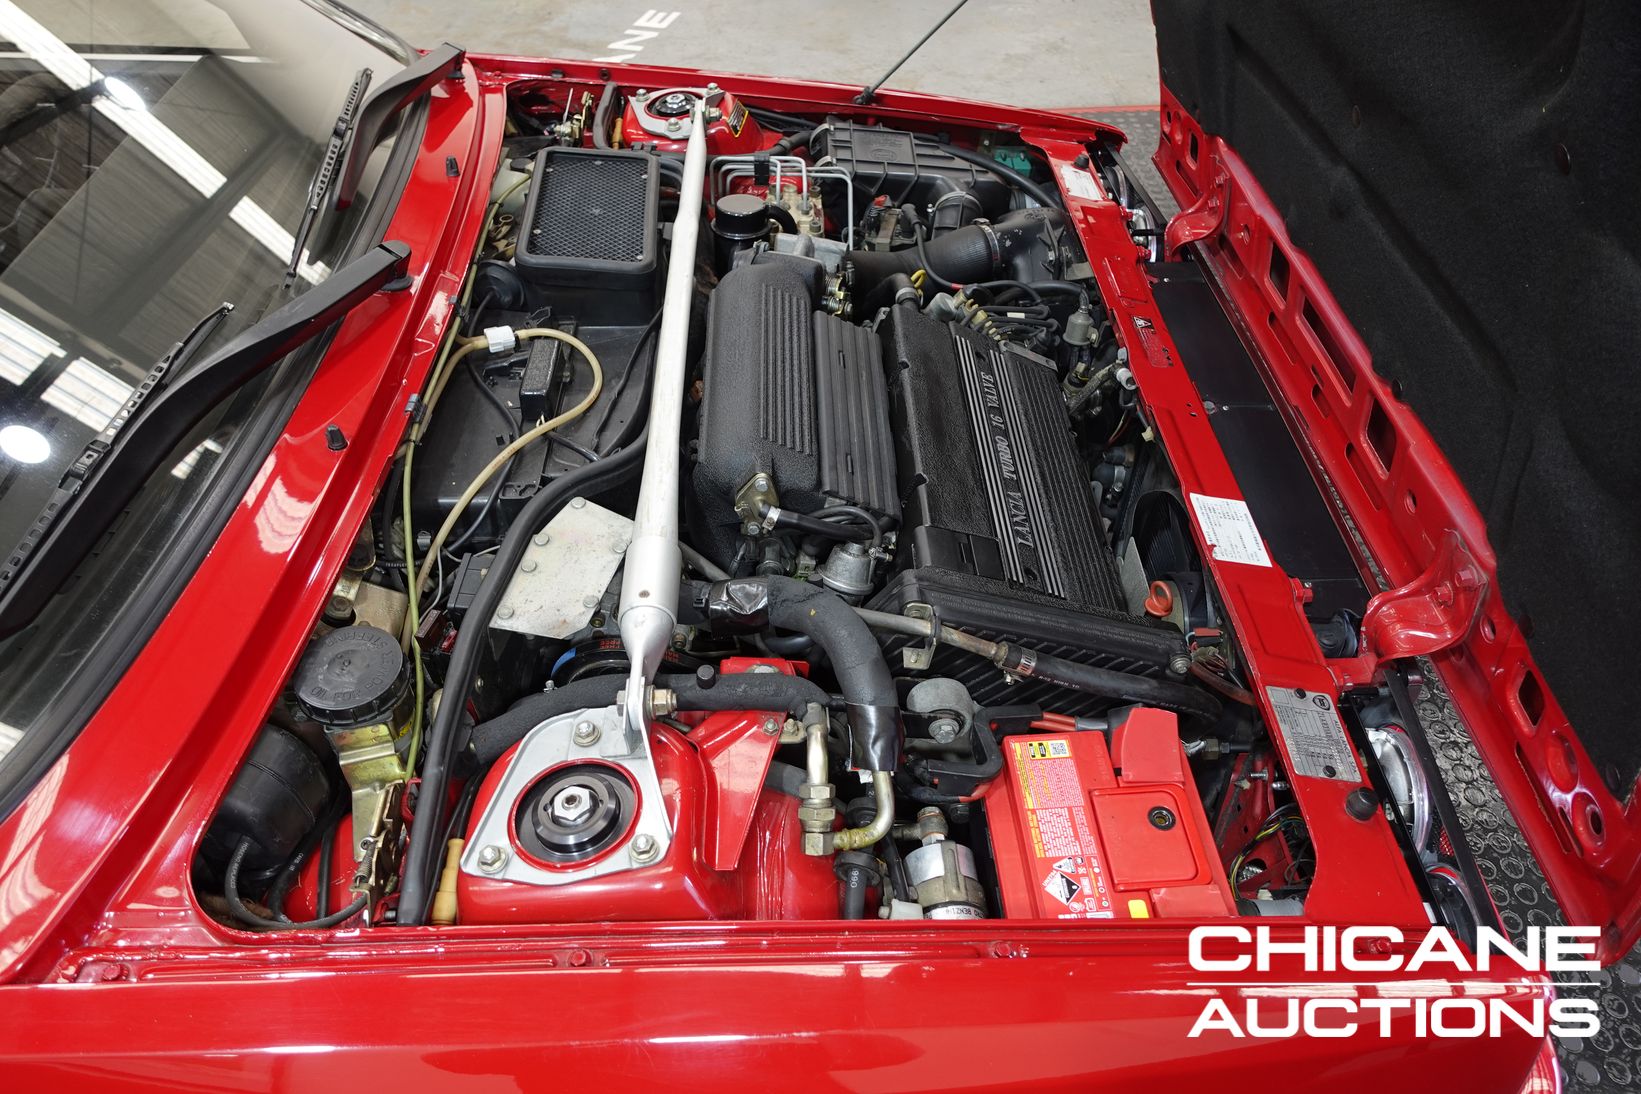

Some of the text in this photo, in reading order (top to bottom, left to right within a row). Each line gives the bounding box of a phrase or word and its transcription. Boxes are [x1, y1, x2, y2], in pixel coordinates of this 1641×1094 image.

[982, 372, 1034, 548] LANCIA TURBO 16 VALVE
[1333, 720, 1342, 733] ALFA
[1339, 736, 1352, 757] LANCIA
